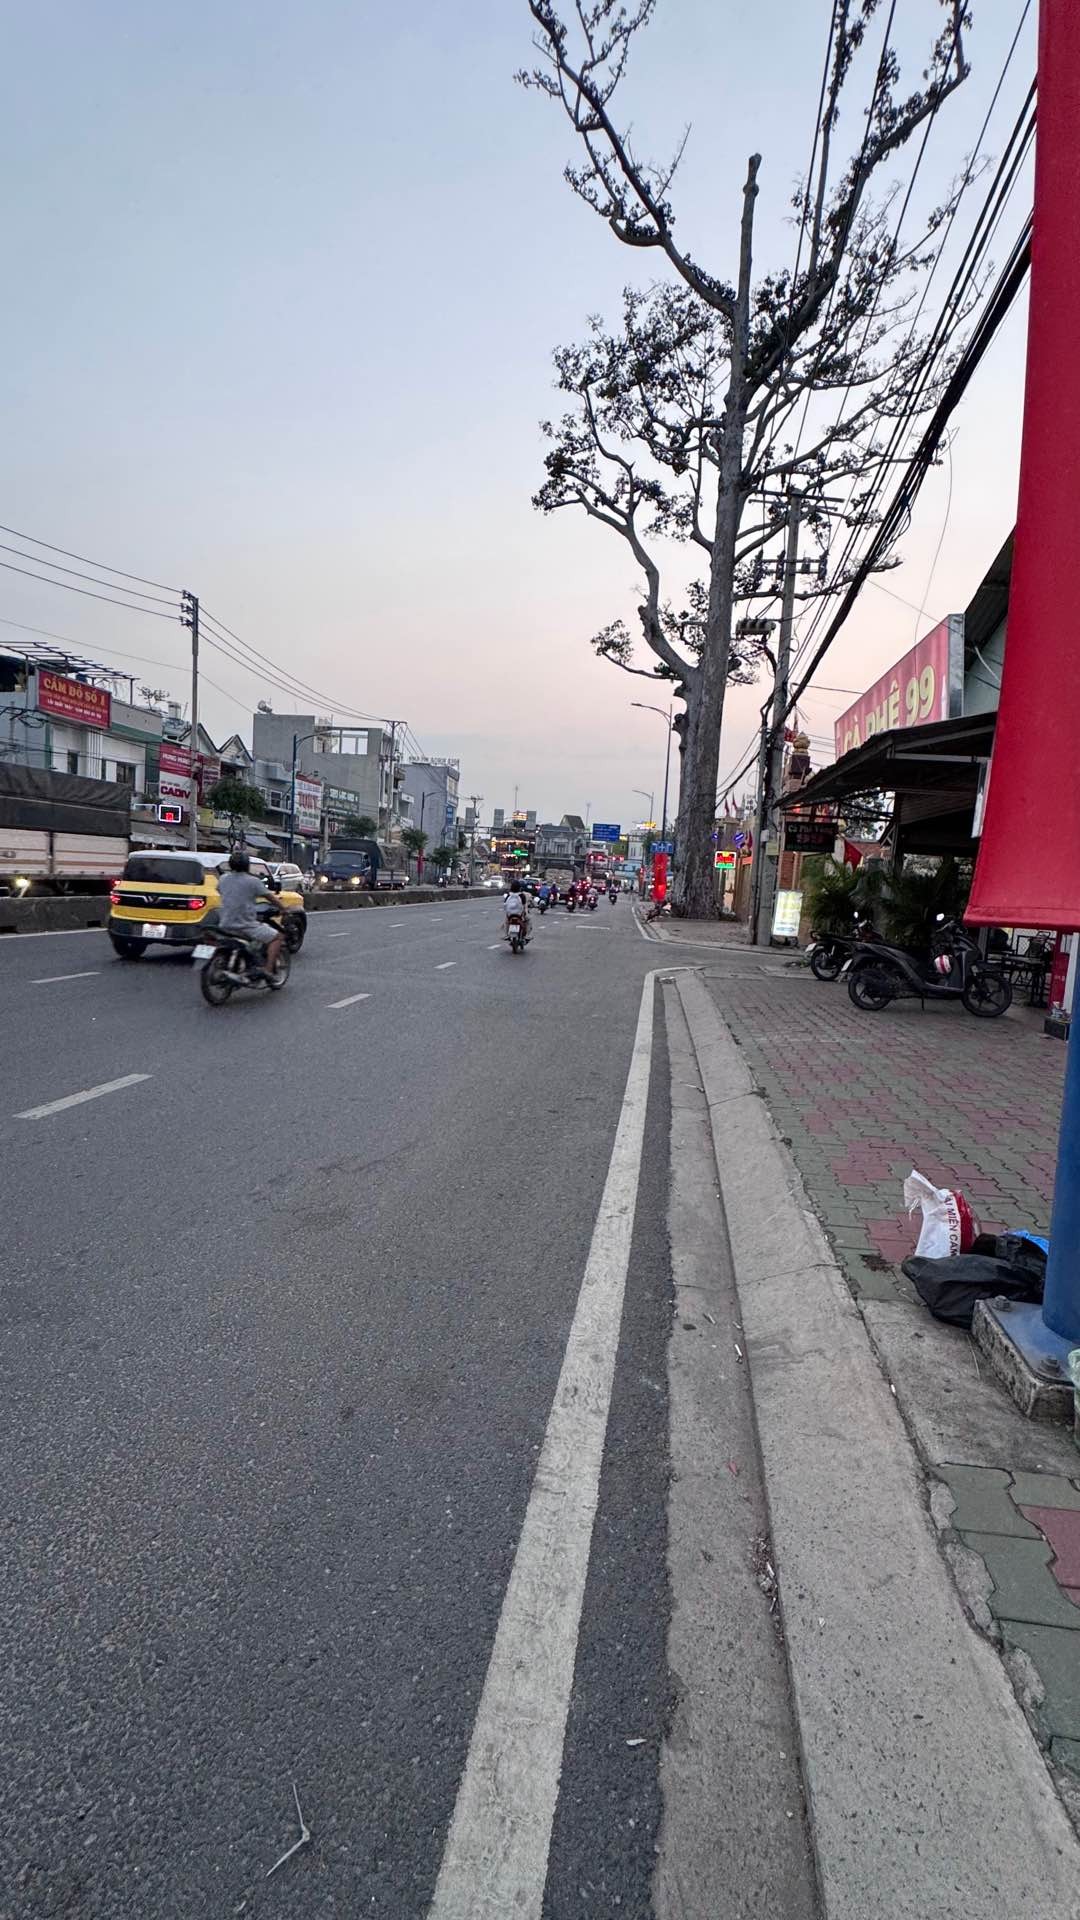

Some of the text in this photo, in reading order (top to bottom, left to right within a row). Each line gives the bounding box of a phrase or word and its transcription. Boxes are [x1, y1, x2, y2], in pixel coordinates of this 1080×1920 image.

[844, 664, 935, 753] CÀ PHÊ 99
[160, 786, 191, 799] CADIV
